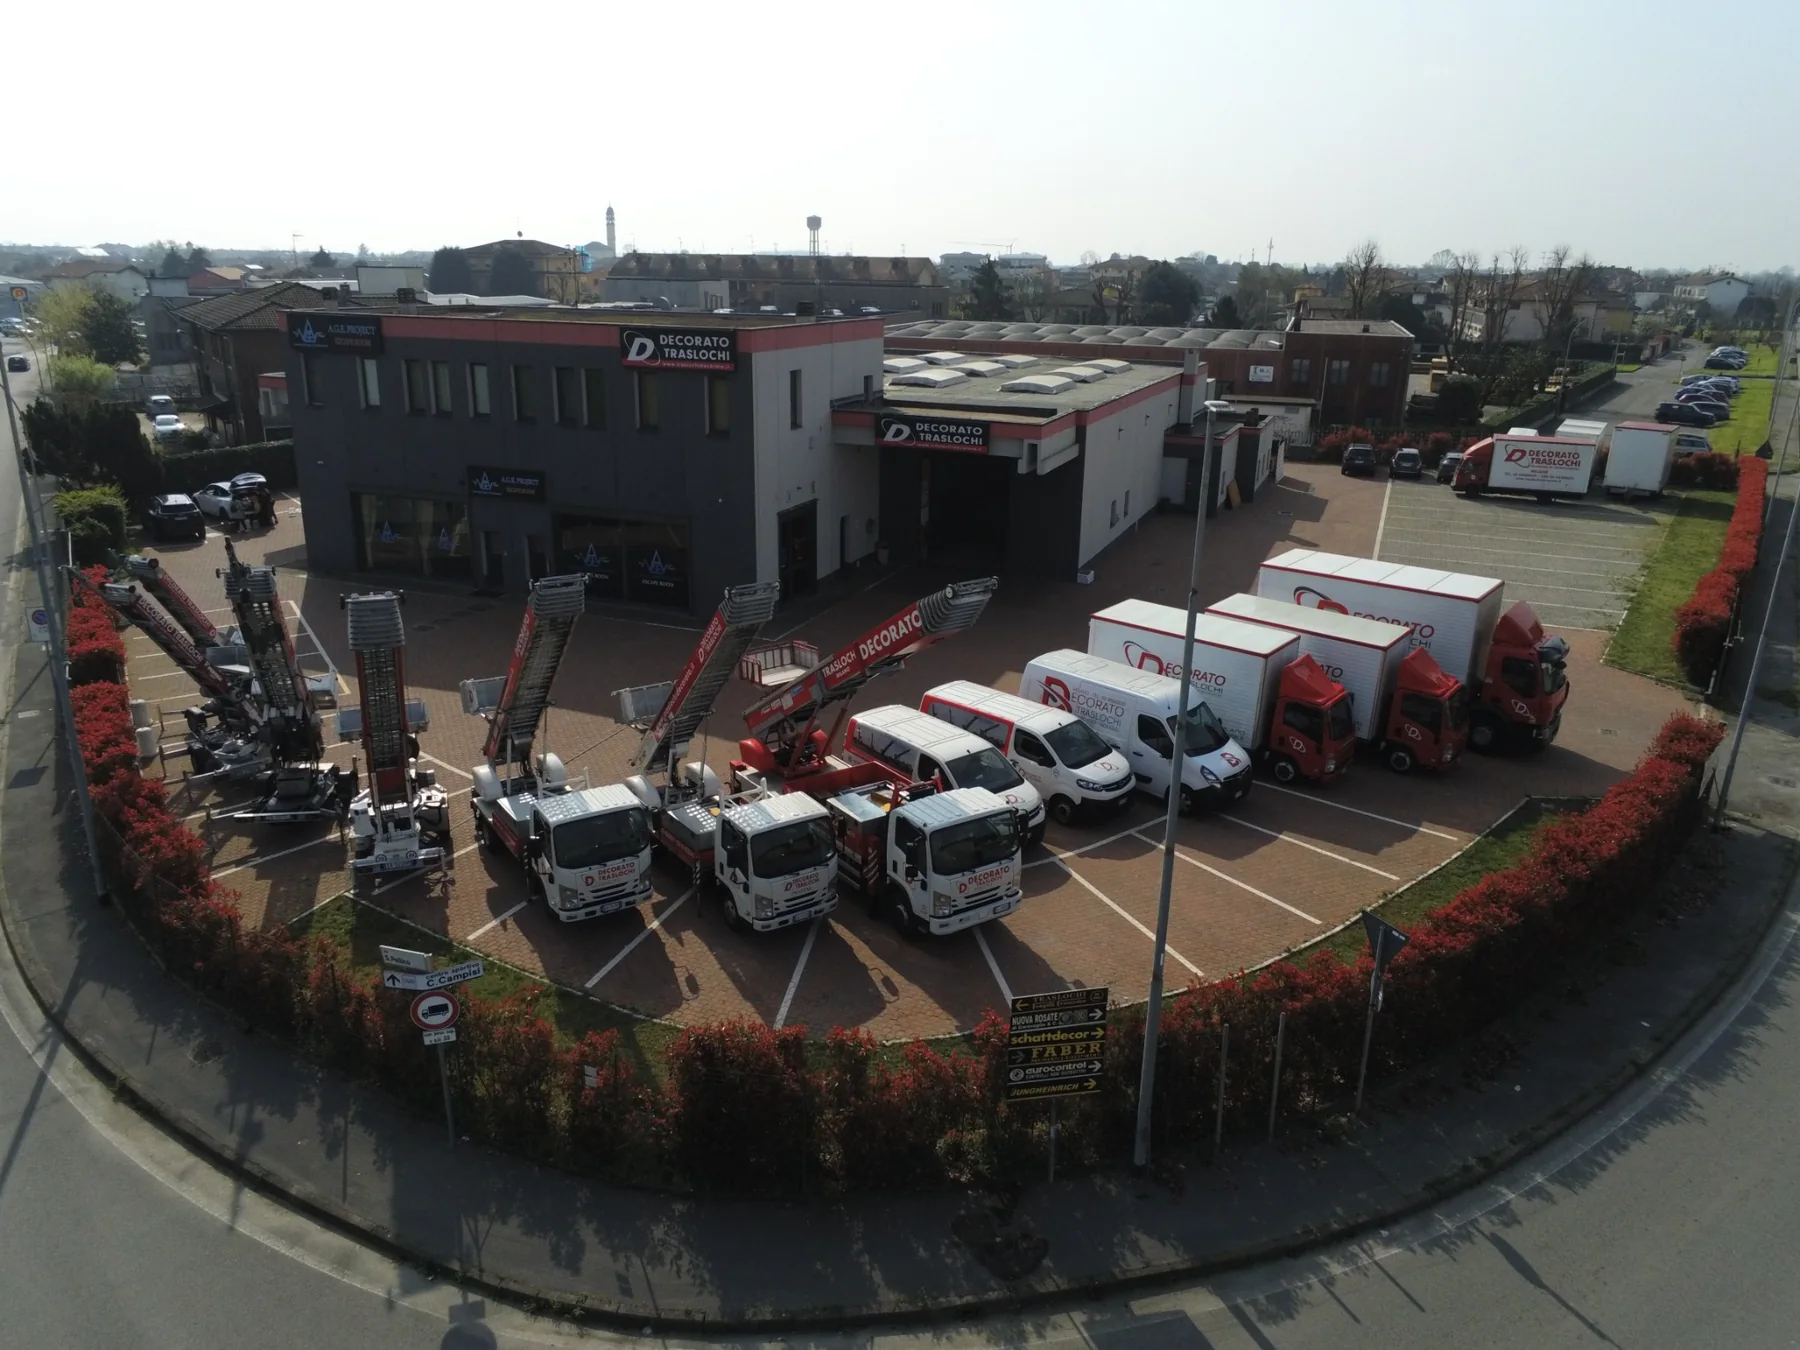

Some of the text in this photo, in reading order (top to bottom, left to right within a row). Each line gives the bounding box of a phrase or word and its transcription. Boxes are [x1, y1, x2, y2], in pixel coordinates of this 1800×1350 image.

[660, 335, 729, 348] DECORATO
[664, 348, 730, 361] TRASLOCHI
[916, 423, 983, 435] DECORATO
[919, 433, 983, 445] TRASLOCHI
[1528, 449, 1580, 460] DECORATO
[1530, 457, 1581, 467] TRASLOCHI
[138, 597, 204, 662] DECORATO TRASLOCHI
[859, 609, 922, 660] DECORATO
[822, 650, 857, 678] TRASLOCH
[1076, 705, 1122, 728] TRASLOCHI
[597, 862, 635, 876] DECORATO
[599, 869, 635, 881] TRASLOCHI
[968, 866, 1010, 885] DECORATO
[451, 962, 480, 974] sportivo
[1033, 991, 1087, 1003] TRASLOCHI
[1011, 1015, 1034, 1026] NUOVA
[1034, 1012, 1059, 1023] ROSATE
[1010, 1030, 1090, 1045] schattdecor
[1031, 1042, 1102, 1060] FABER
[1025, 1061, 1087, 1075] eurocontrol
[1010, 1082, 1080, 1097] JUNGHEINRICH
